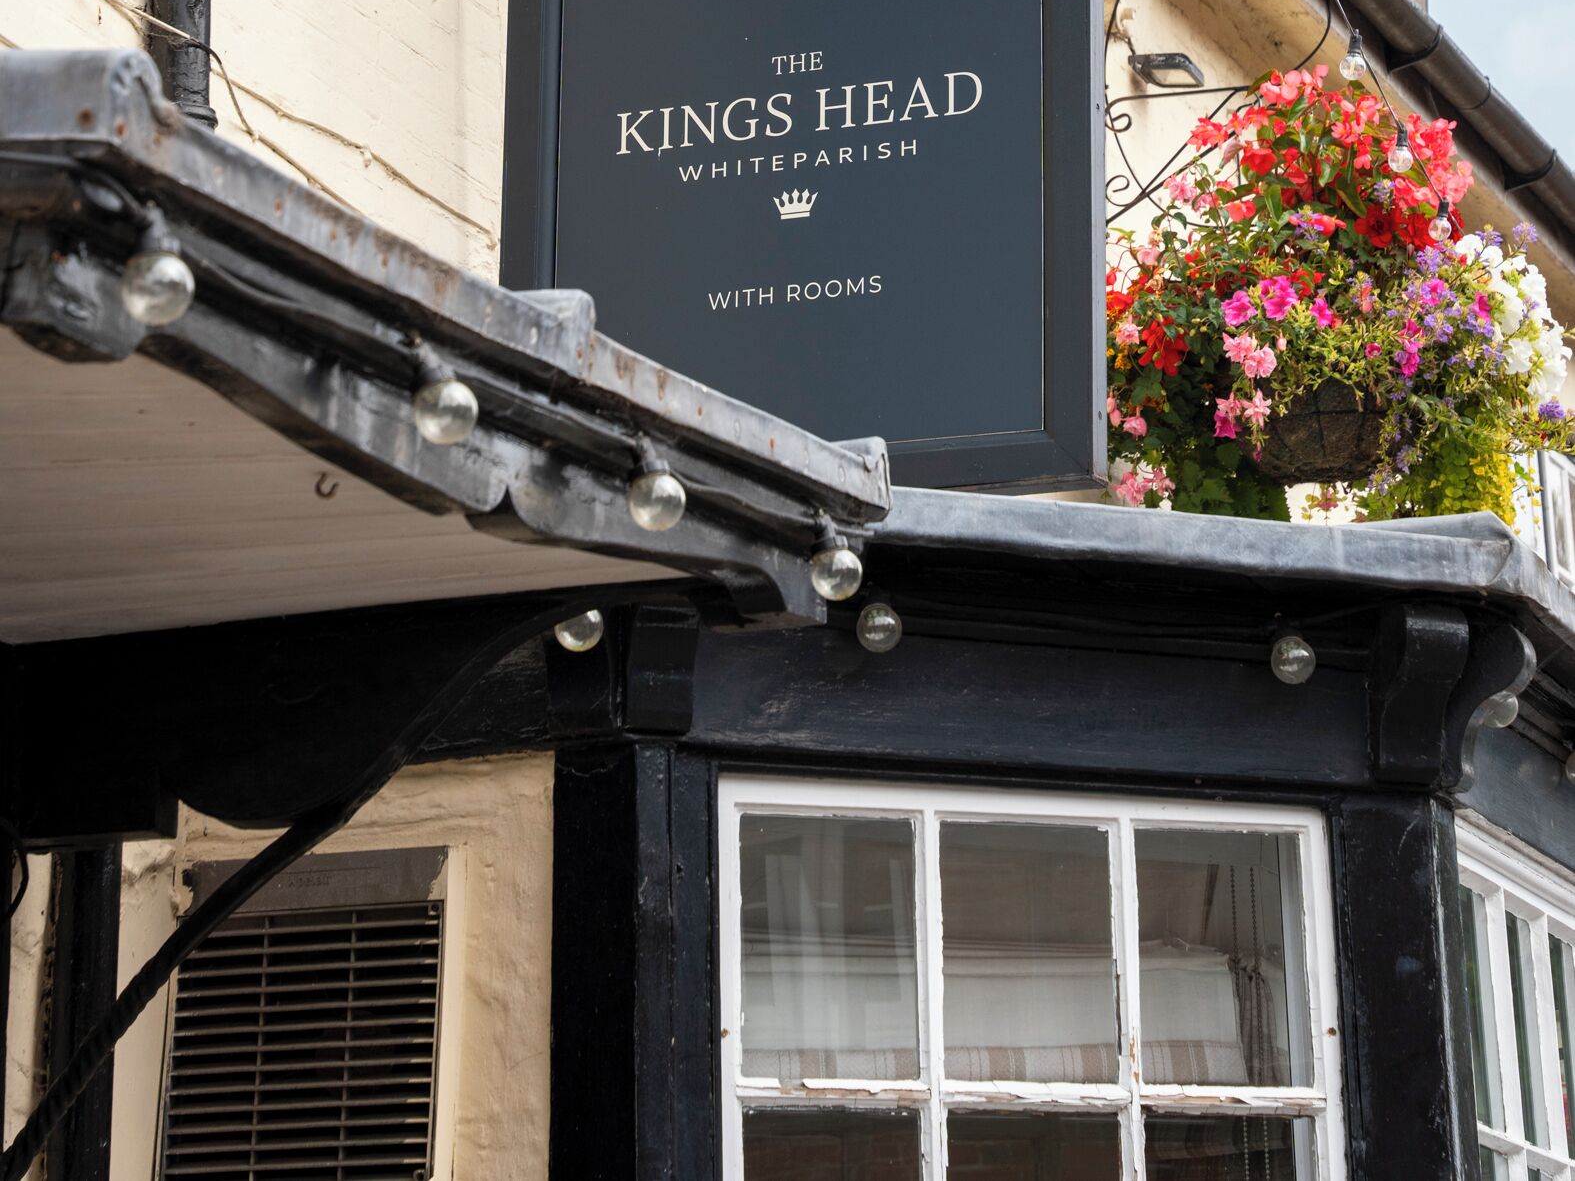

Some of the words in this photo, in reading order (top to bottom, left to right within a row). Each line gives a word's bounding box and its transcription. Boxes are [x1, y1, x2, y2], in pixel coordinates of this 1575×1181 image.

[771, 50, 824, 76] THE
[615, 92, 793, 156] KINGS
[814, 71, 983, 132] HEAD
[678, 139, 917, 182] WHITEPARISH
[708, 286, 774, 311] WITH
[786, 275, 882, 303] ROOMS
